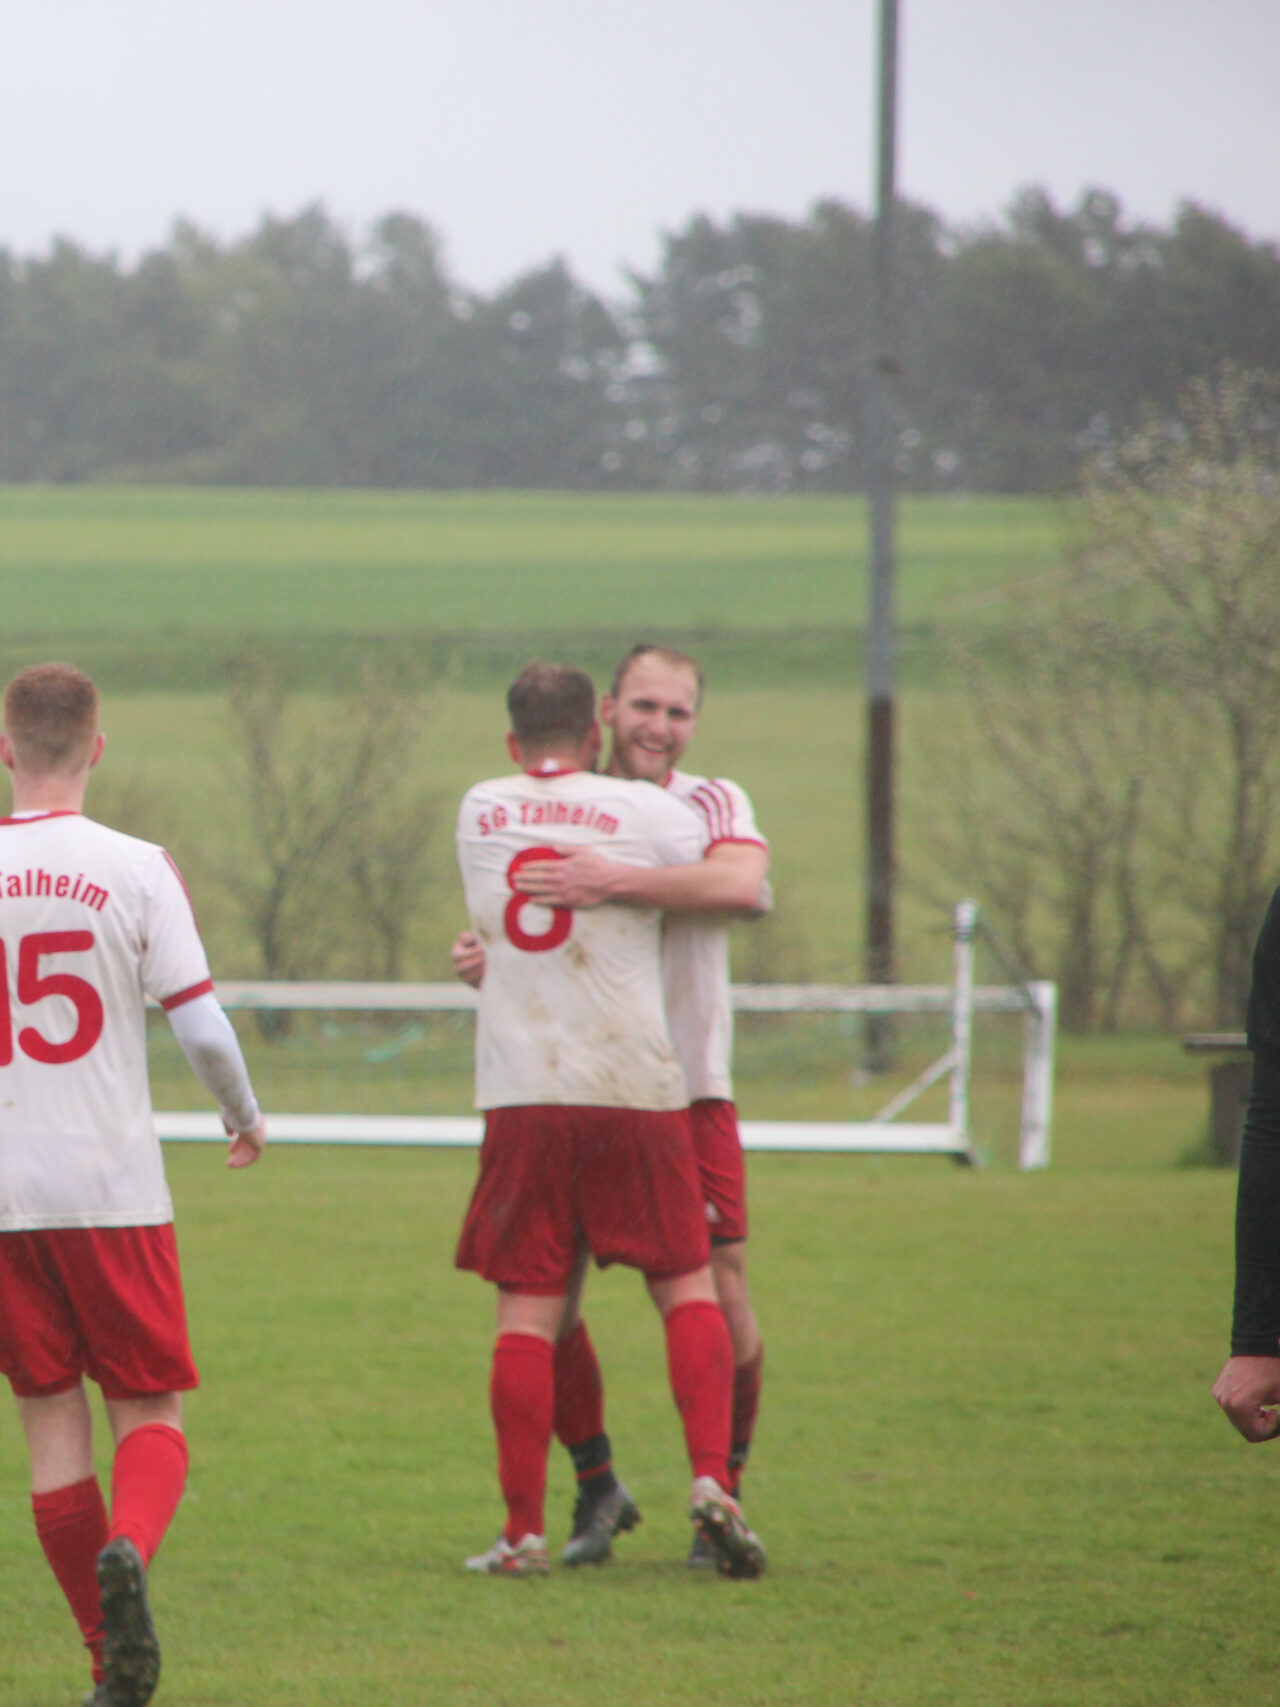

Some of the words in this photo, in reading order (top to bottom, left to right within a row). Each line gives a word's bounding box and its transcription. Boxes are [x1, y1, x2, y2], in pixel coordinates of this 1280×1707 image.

[478, 804, 510, 837] SG
[520, 801, 621, 836] Talheim
[503, 846, 574, 954] 8
